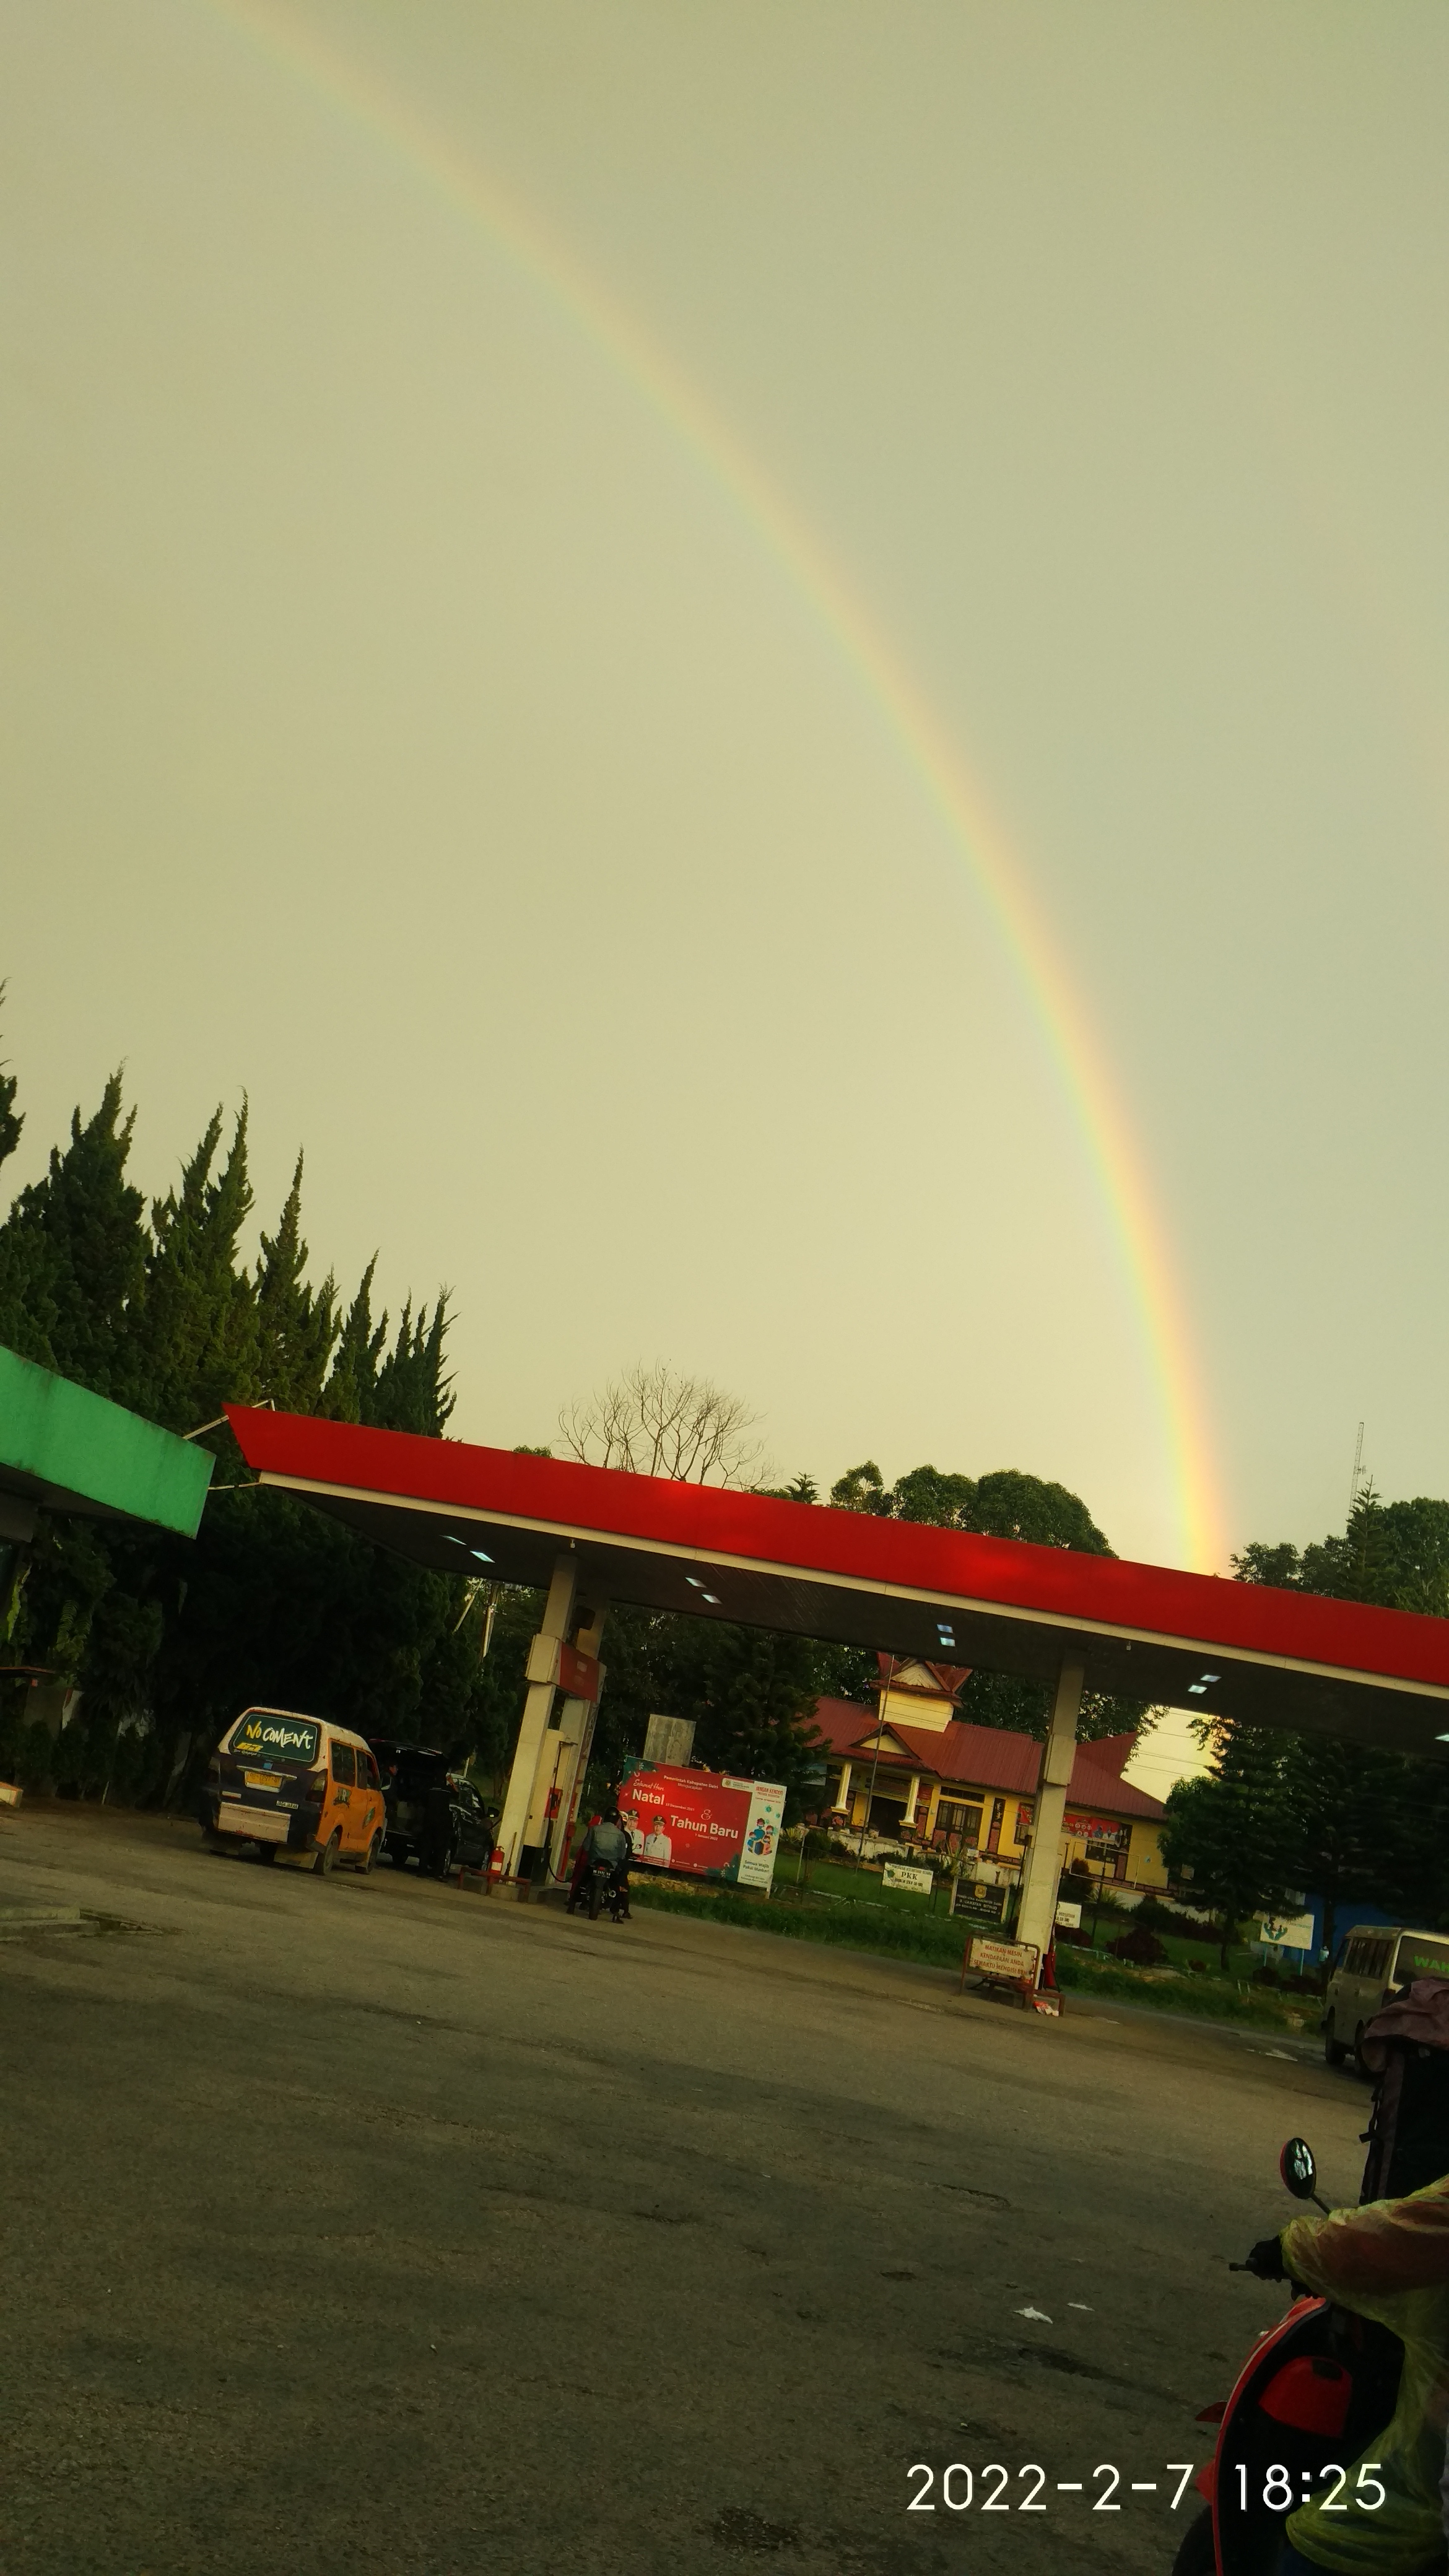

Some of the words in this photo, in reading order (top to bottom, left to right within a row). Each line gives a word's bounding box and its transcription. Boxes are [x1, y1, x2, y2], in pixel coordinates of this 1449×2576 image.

[632, 1788, 665, 1805] Natal
[700, 1809, 712, 1821] &
[671, 1815, 707, 1833] Tahun
[710, 1822, 739, 1839] Baru
[901, 1871, 918, 1880] PKK
[985, 1944, 1006, 1954] MATIKAN
[1007, 1949, 1022, 1957] MESIN
[973, 1959, 996, 1969] SEWAKTU
